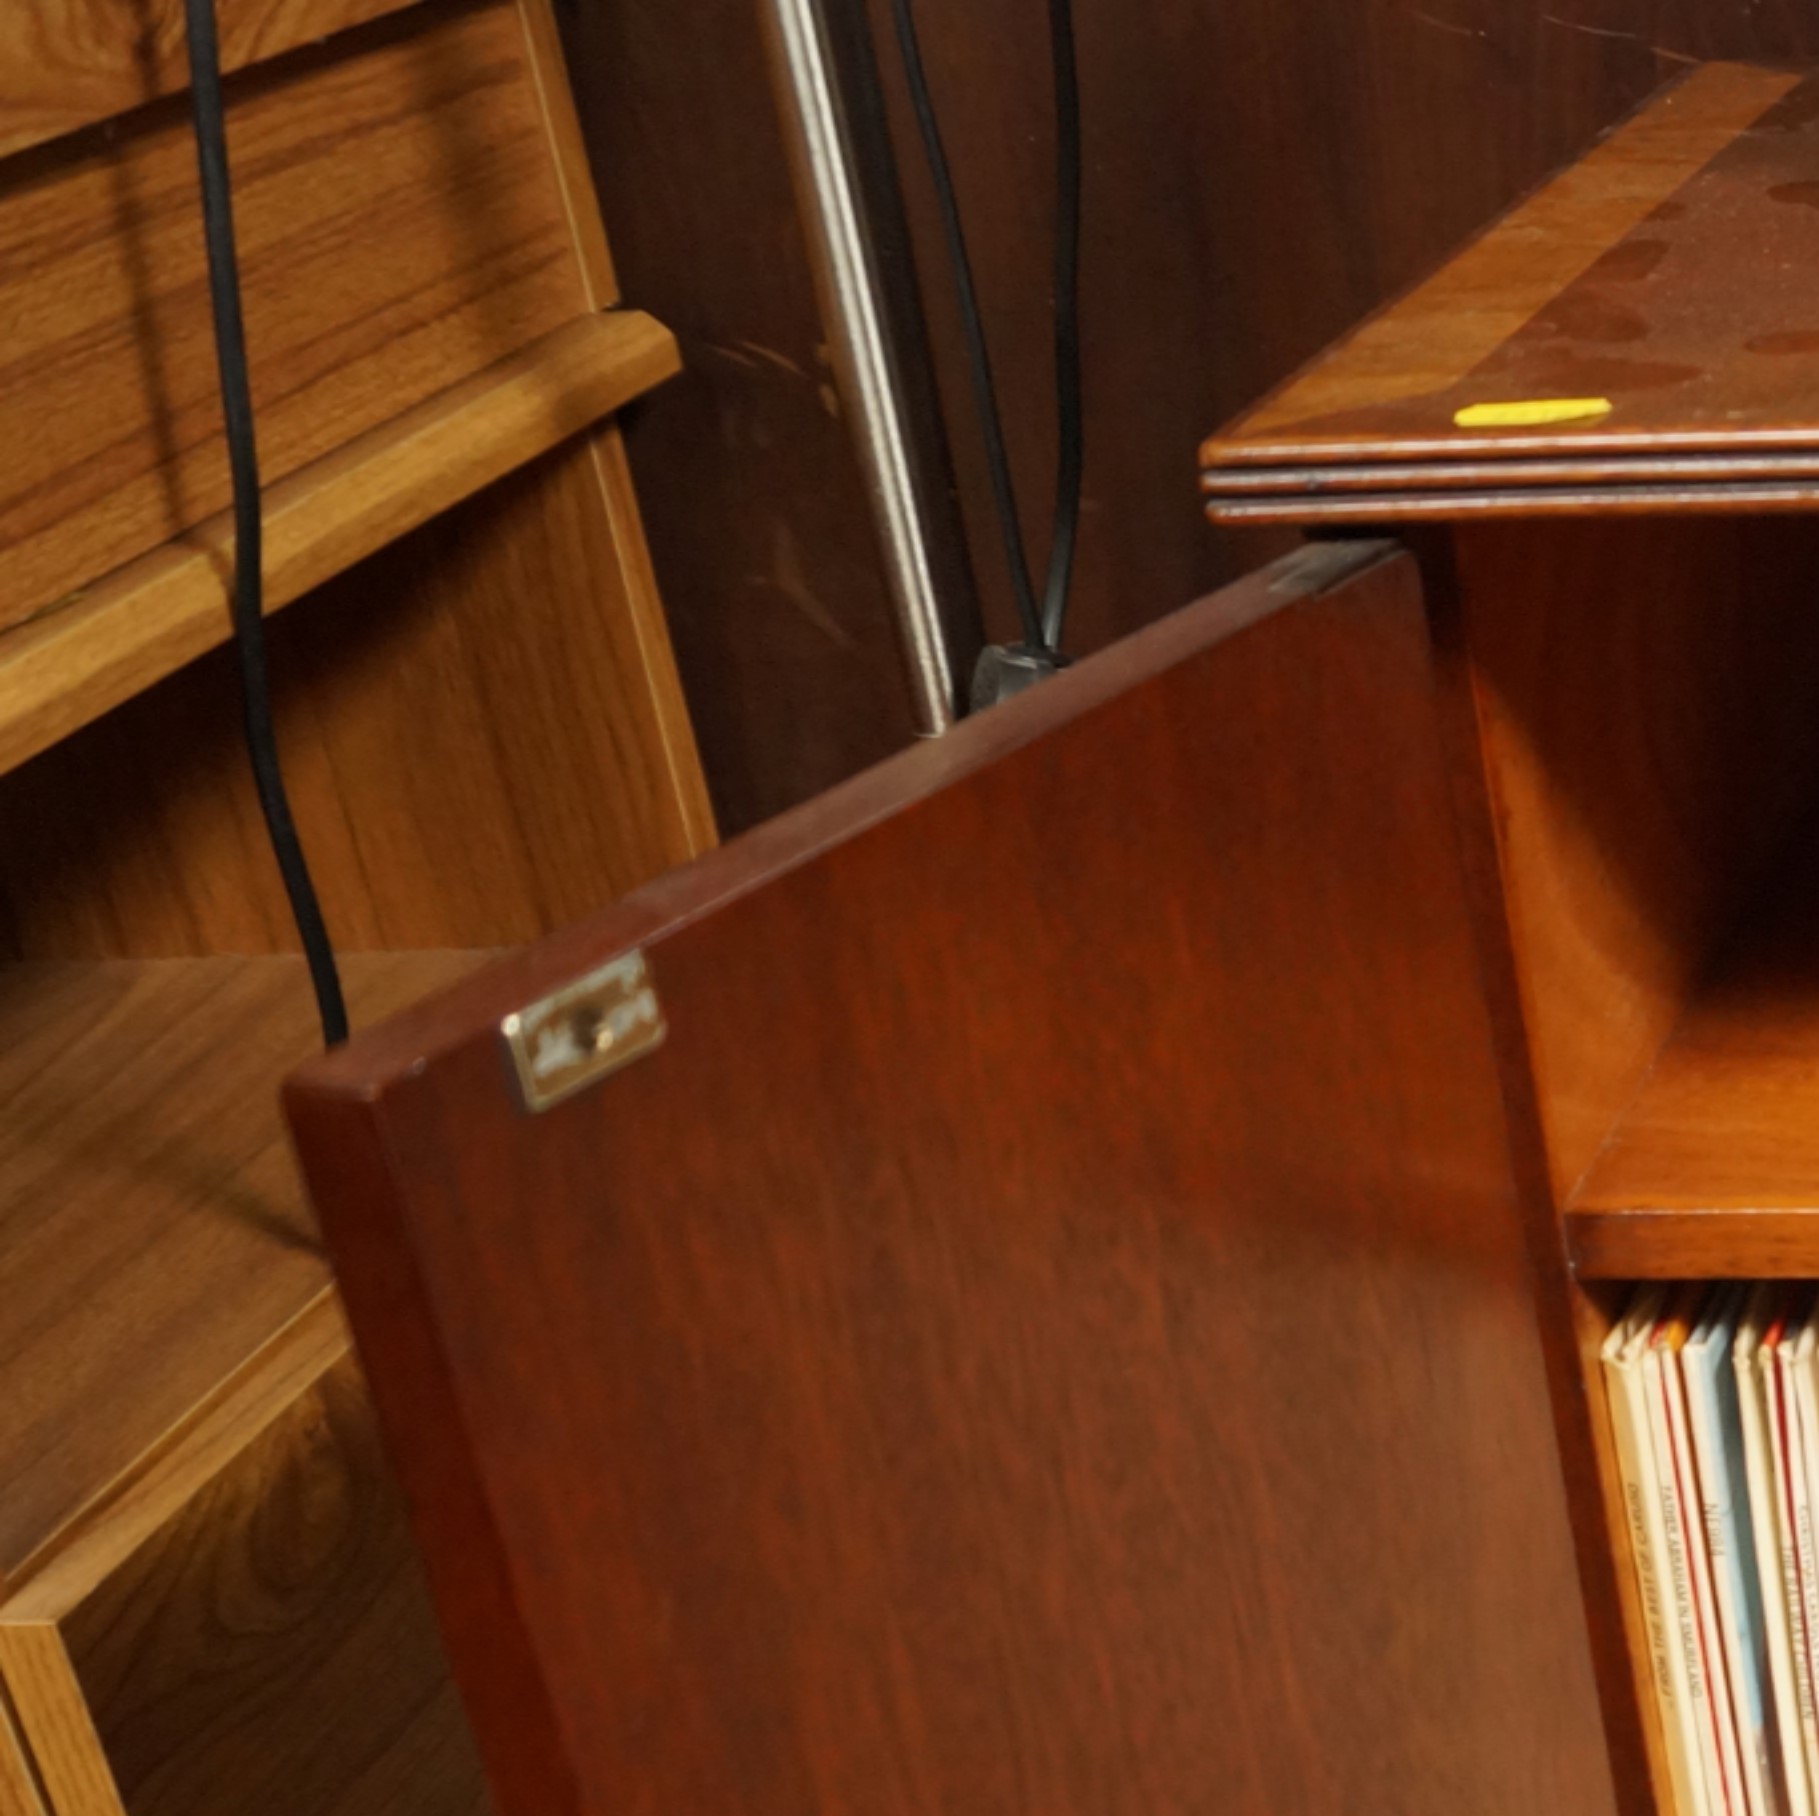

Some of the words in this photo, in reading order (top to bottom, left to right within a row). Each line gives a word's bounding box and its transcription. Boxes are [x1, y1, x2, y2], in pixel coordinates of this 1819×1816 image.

[1661, 1486, 1681, 1534] FATHER
[1668, 1539, 1690, 1602] ABRAHAM
[1677, 1606, 1692, 1619] IN
[1679, 1622, 1703, 1699] SMURFLAND
